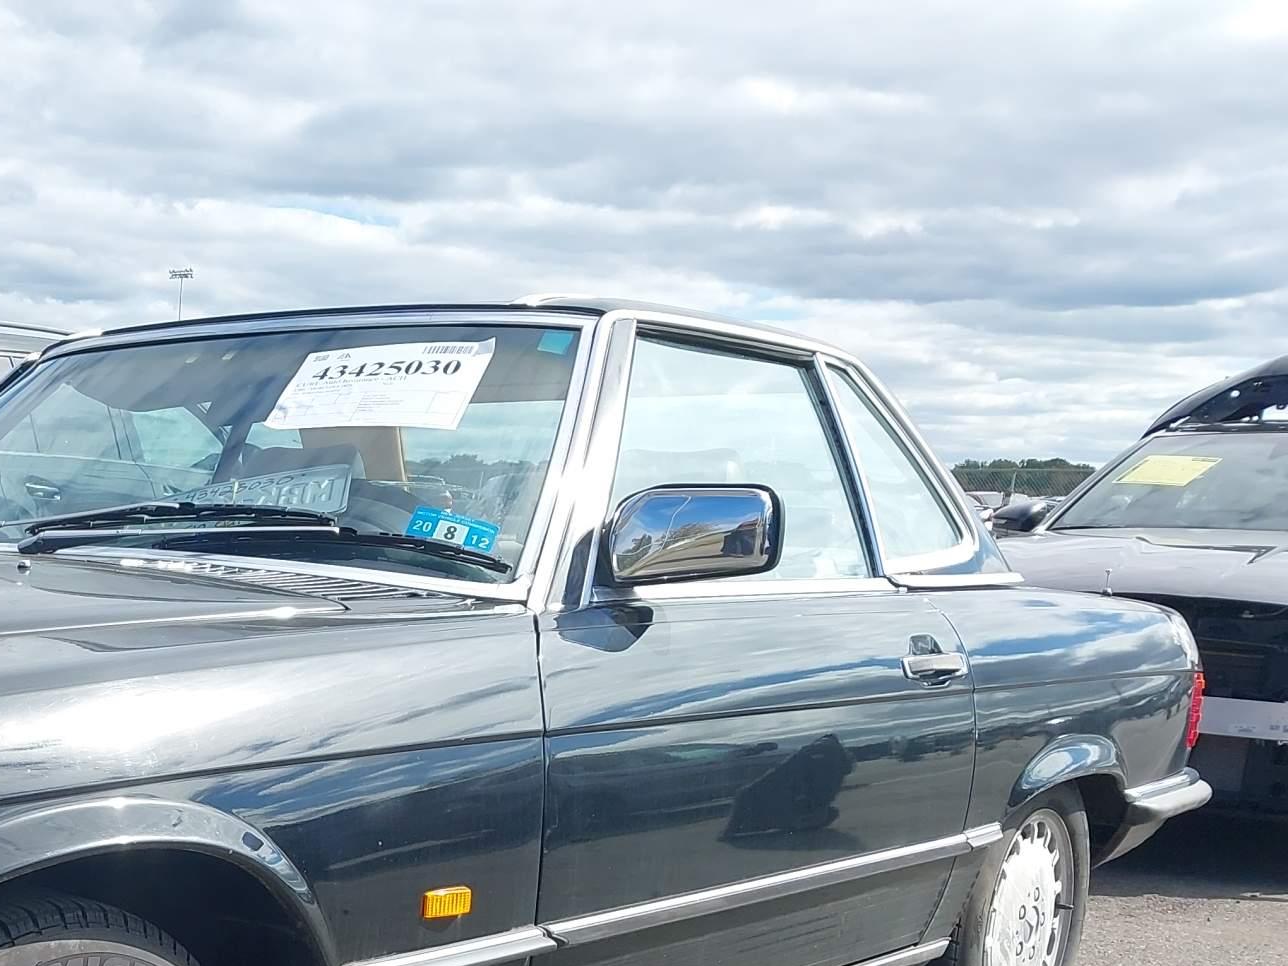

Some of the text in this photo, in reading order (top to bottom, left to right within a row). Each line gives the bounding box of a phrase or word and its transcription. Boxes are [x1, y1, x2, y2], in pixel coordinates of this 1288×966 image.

[312, 359, 462, 381] 43425030
[413, 520, 432, 532] 20
[443, 526, 457, 540] 8
[472, 535, 489, 549] 12
